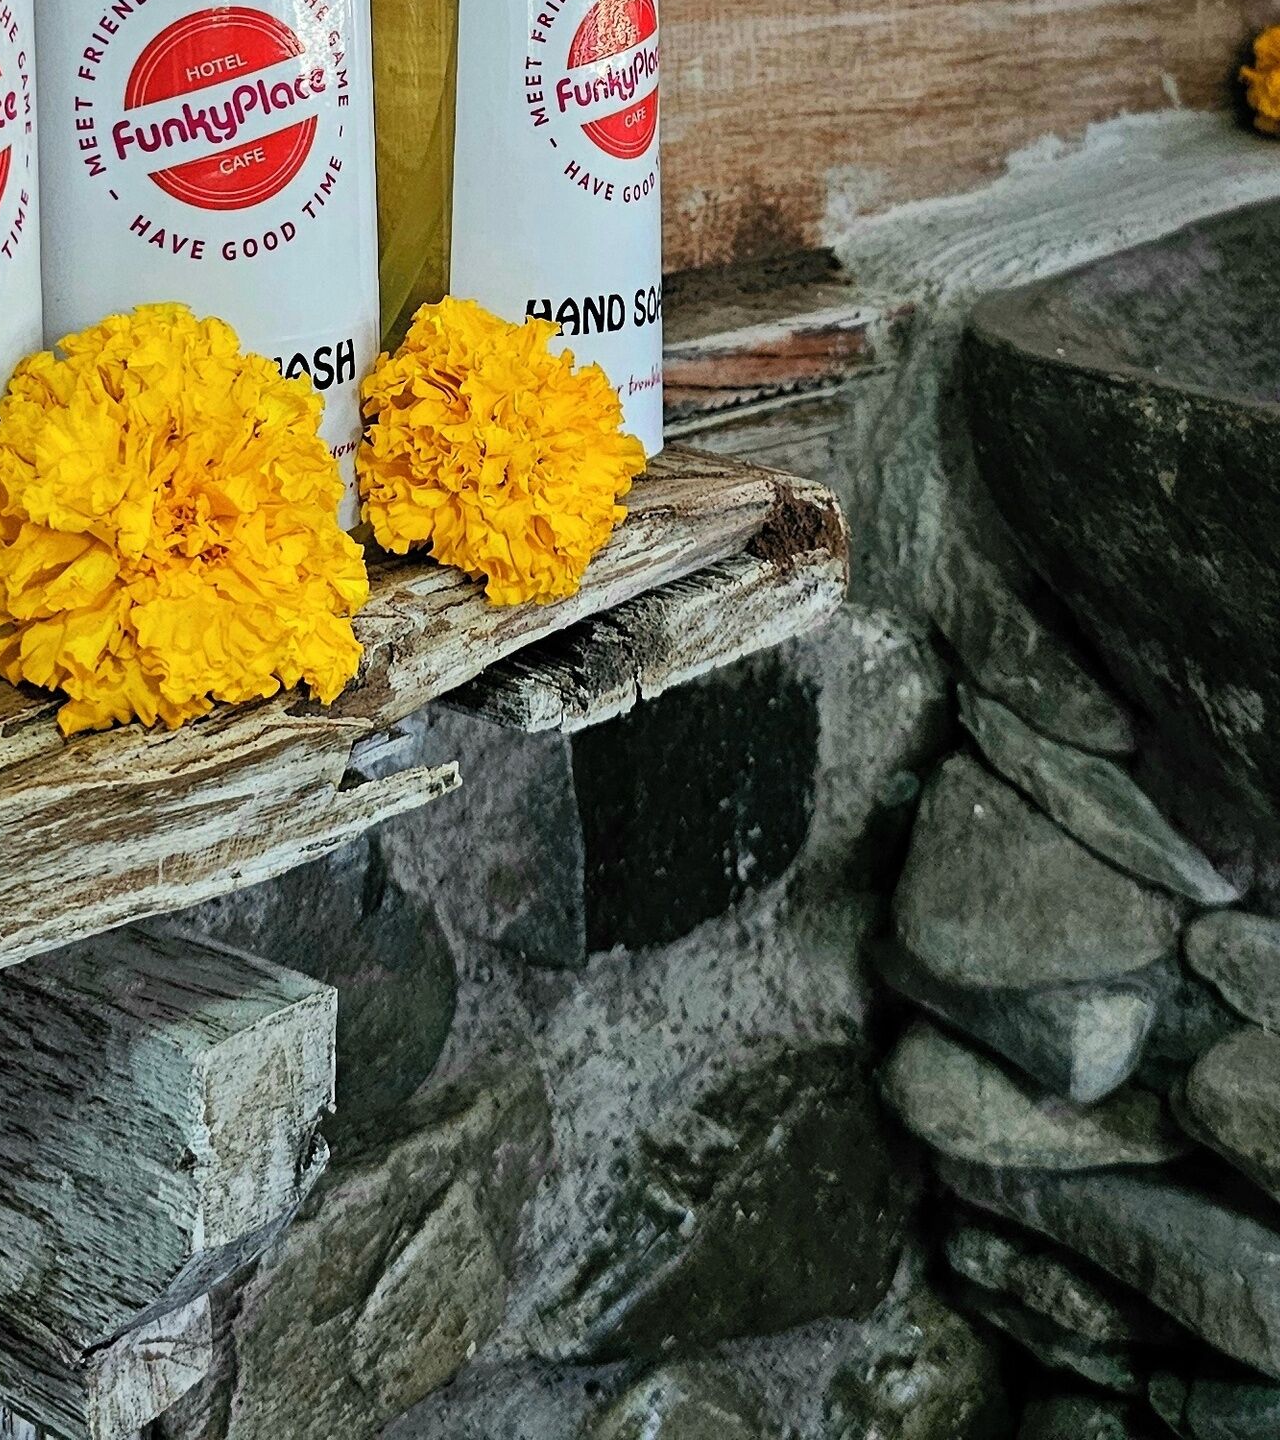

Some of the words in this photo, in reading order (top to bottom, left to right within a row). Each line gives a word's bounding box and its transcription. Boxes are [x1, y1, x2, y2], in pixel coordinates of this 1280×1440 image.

[18, 51, 32, 135] GAME
[185, 51, 248, 82] HOTEL
[525, 56, 551, 127] MEET
[74, 95, 107, 178] MEET
[328, 30, 350, 107] GAME
[111, 68, 327, 160] FunkyPlace
[624, 107, 647, 129] CAFE
[219, 147, 267, 176] CAFE
[564, 159, 614, 201] HAVE
[623, 171, 655, 203] GOOD
[1, 190, 30, 259] TIME
[129, 214, 206, 260] HAVE
[221, 220, 296, 261] GOOD
[301, 155, 344, 220] TIME
[525, 293, 625, 336] HAND
[273, 338, 356, 390] ASH
